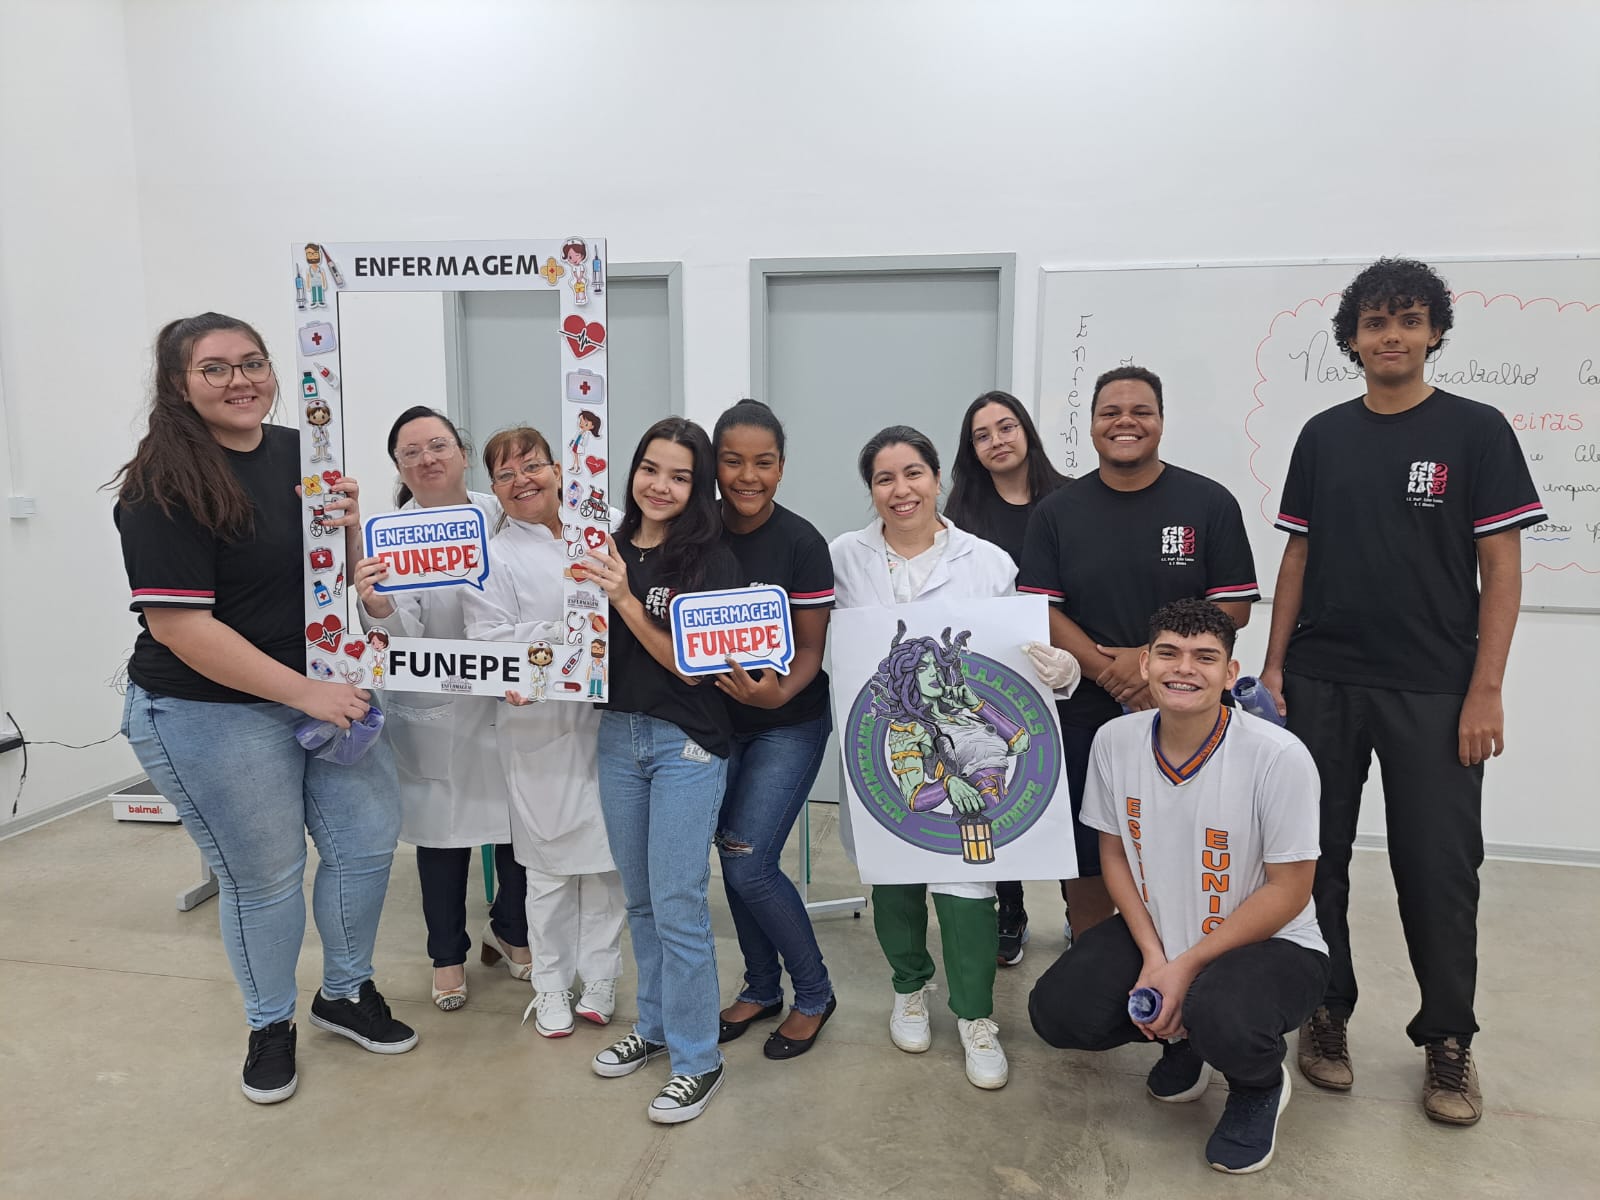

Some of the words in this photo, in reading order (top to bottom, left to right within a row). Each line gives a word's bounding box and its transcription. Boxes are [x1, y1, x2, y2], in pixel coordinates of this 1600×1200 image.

[354, 254, 540, 277] ENFERMAGEM
[1512, 412, 1583, 431] eiras
[375, 520, 480, 547] ENFERMAGEM
[378, 544, 479, 576] FUNEPE
[683, 601, 781, 628] ENFERMAGEM
[686, 625, 781, 658] FUNEPE
[389, 650, 520, 682] FUNEPE
[991, 779, 1044, 835] FUNEPE
